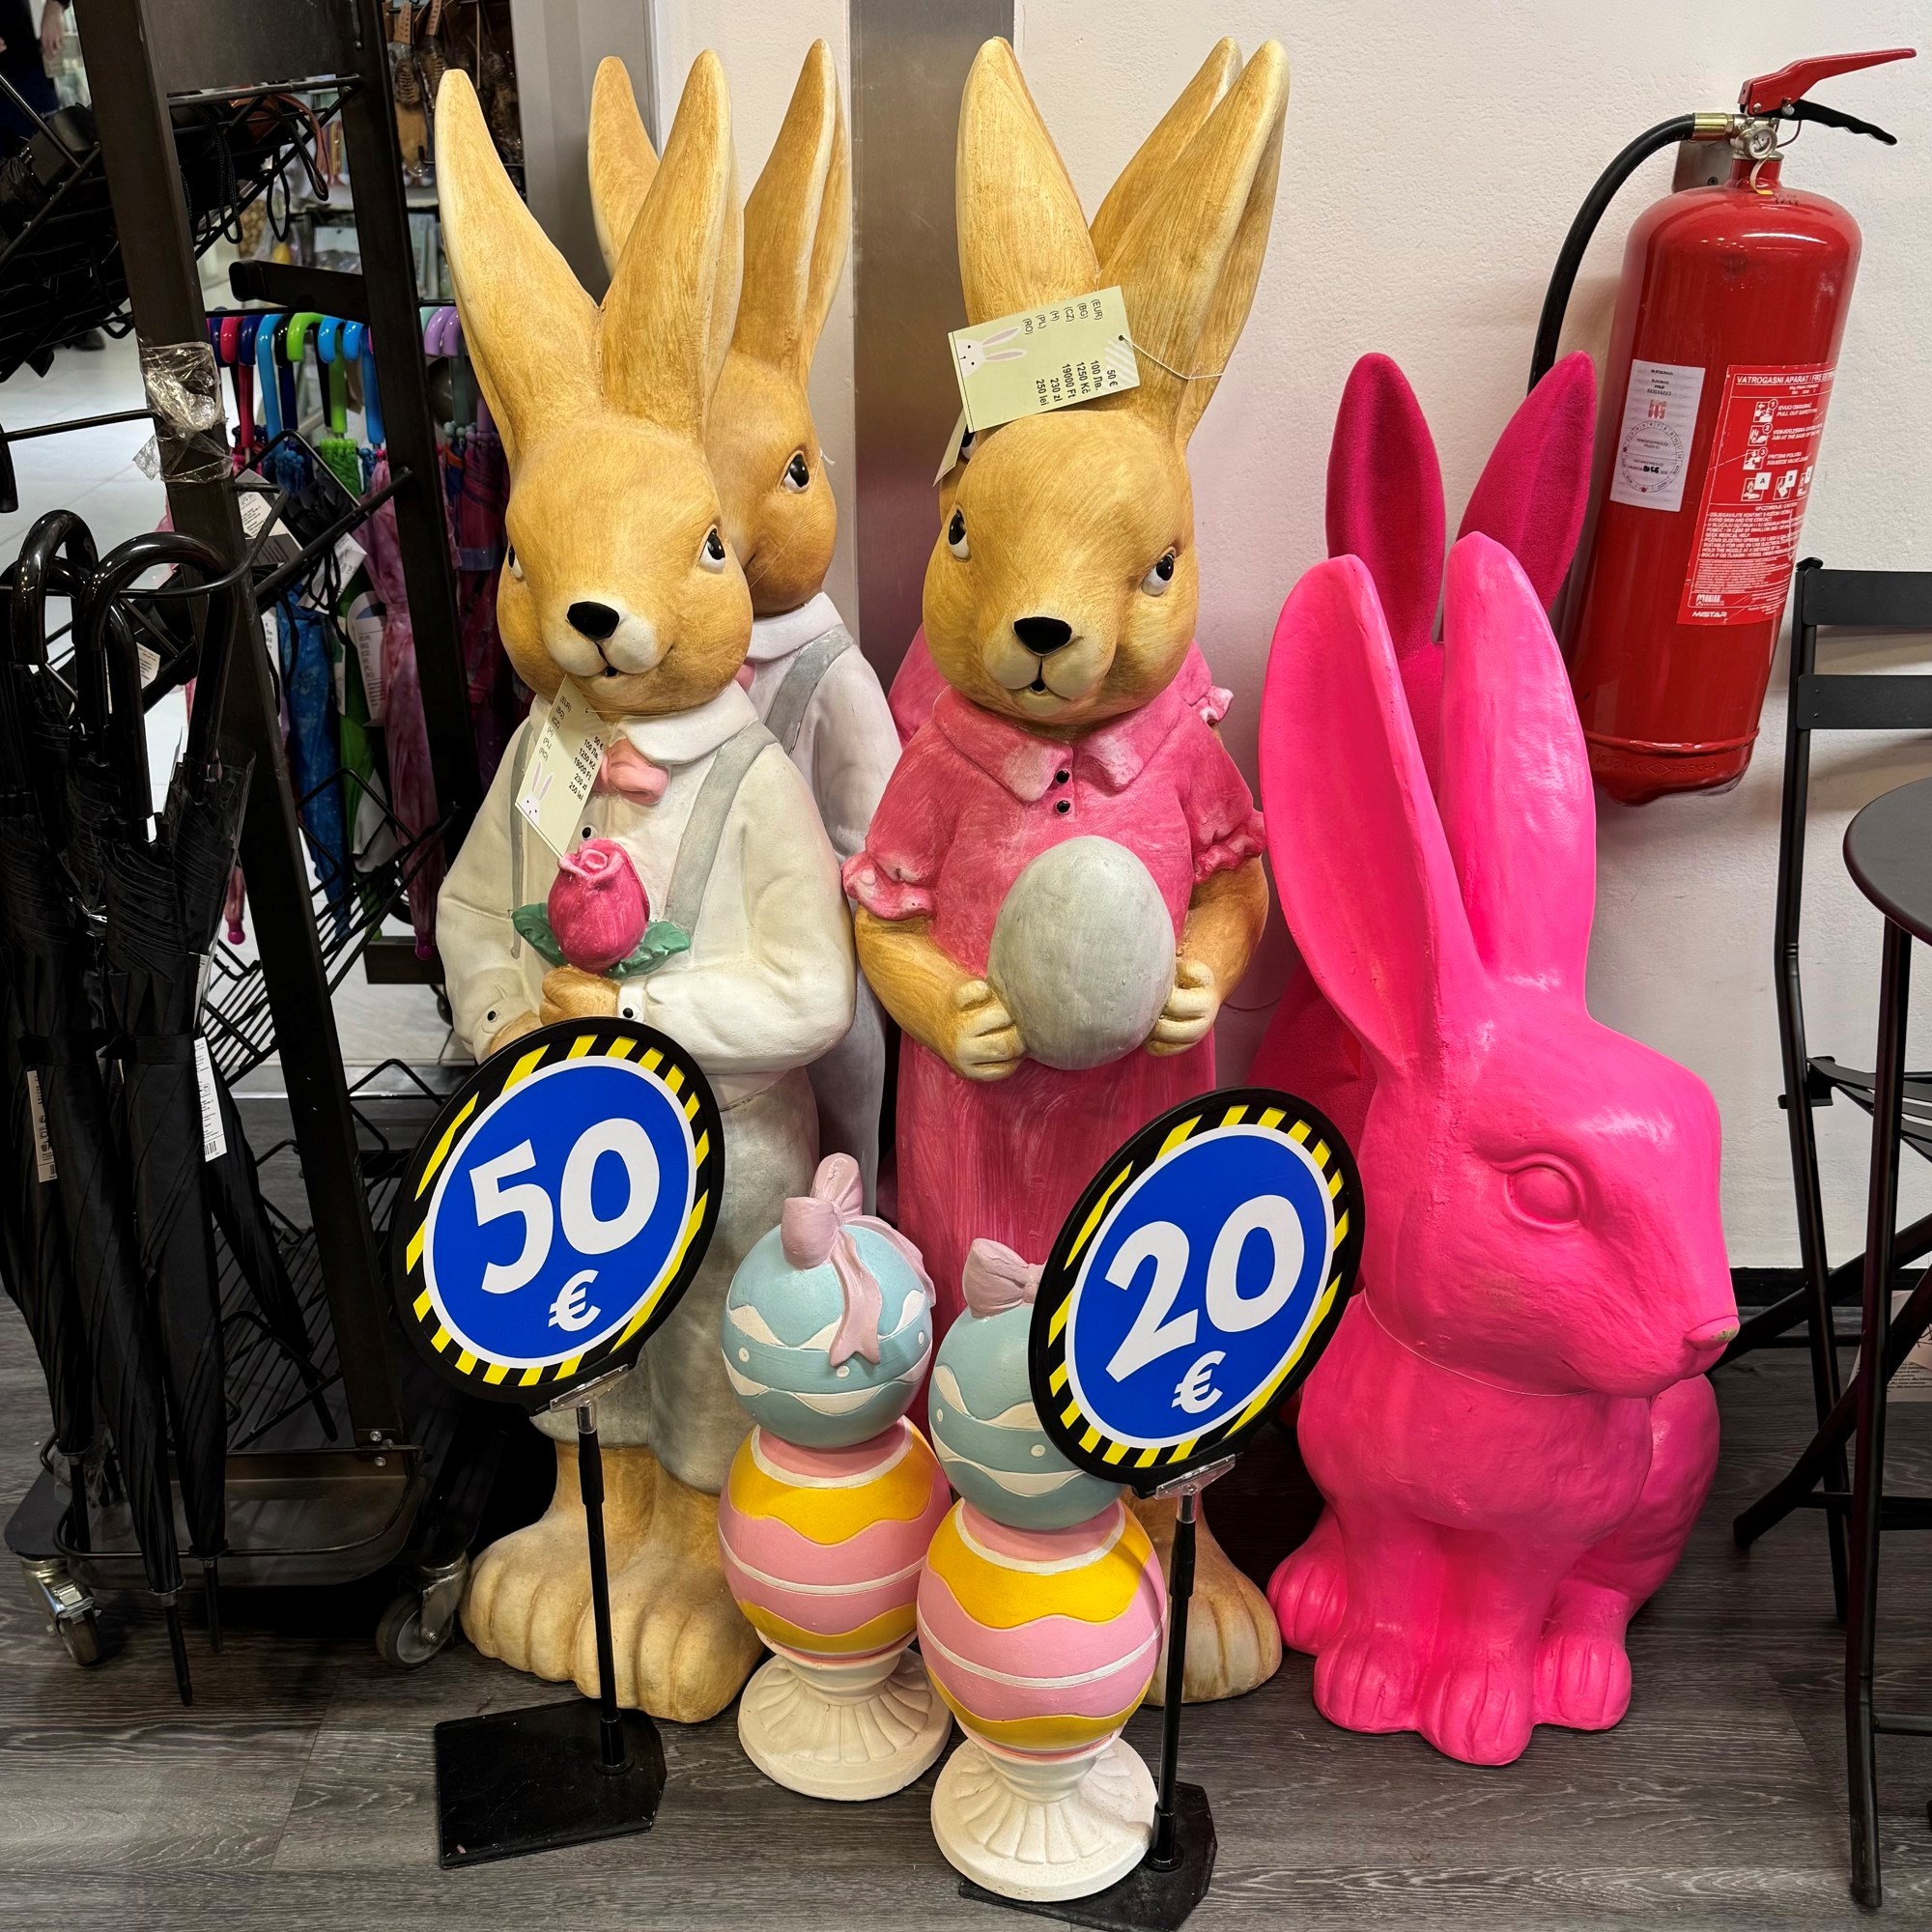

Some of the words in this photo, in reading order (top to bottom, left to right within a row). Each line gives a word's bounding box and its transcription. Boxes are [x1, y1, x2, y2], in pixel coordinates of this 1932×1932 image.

[1050, 310, 1060, 322] (H)
[1064, 306, 1075, 323] (CZ)
[1077, 302, 1089, 319] (BG)
[1091, 360, 1101, 375] 100
[1091, 298, 1103, 321] (EUR)
[1107, 369, 1117, 380] 50
[1022, 318, 1034, 335] (RO)
[1036, 379, 1047, 394] 250
[1037, 314, 1047, 329] (PL)
[1050, 378, 1061, 393] 230
[1063, 363, 1075, 388] 19000
[1076, 361, 1088, 382] 1250
[1737, 376, 1784, 384] VATROGASNI
[1784, 375, 1809, 384] APARAT
[1067, 388, 1076, 399] Ft
[1080, 383, 1091, 394] Kč
[469, 1118, 661, 1295] 50
[548, 1269, 602, 1332] €
[1104, 1194, 1305, 1384] 20
[1171, 1350, 1227, 1414] €
